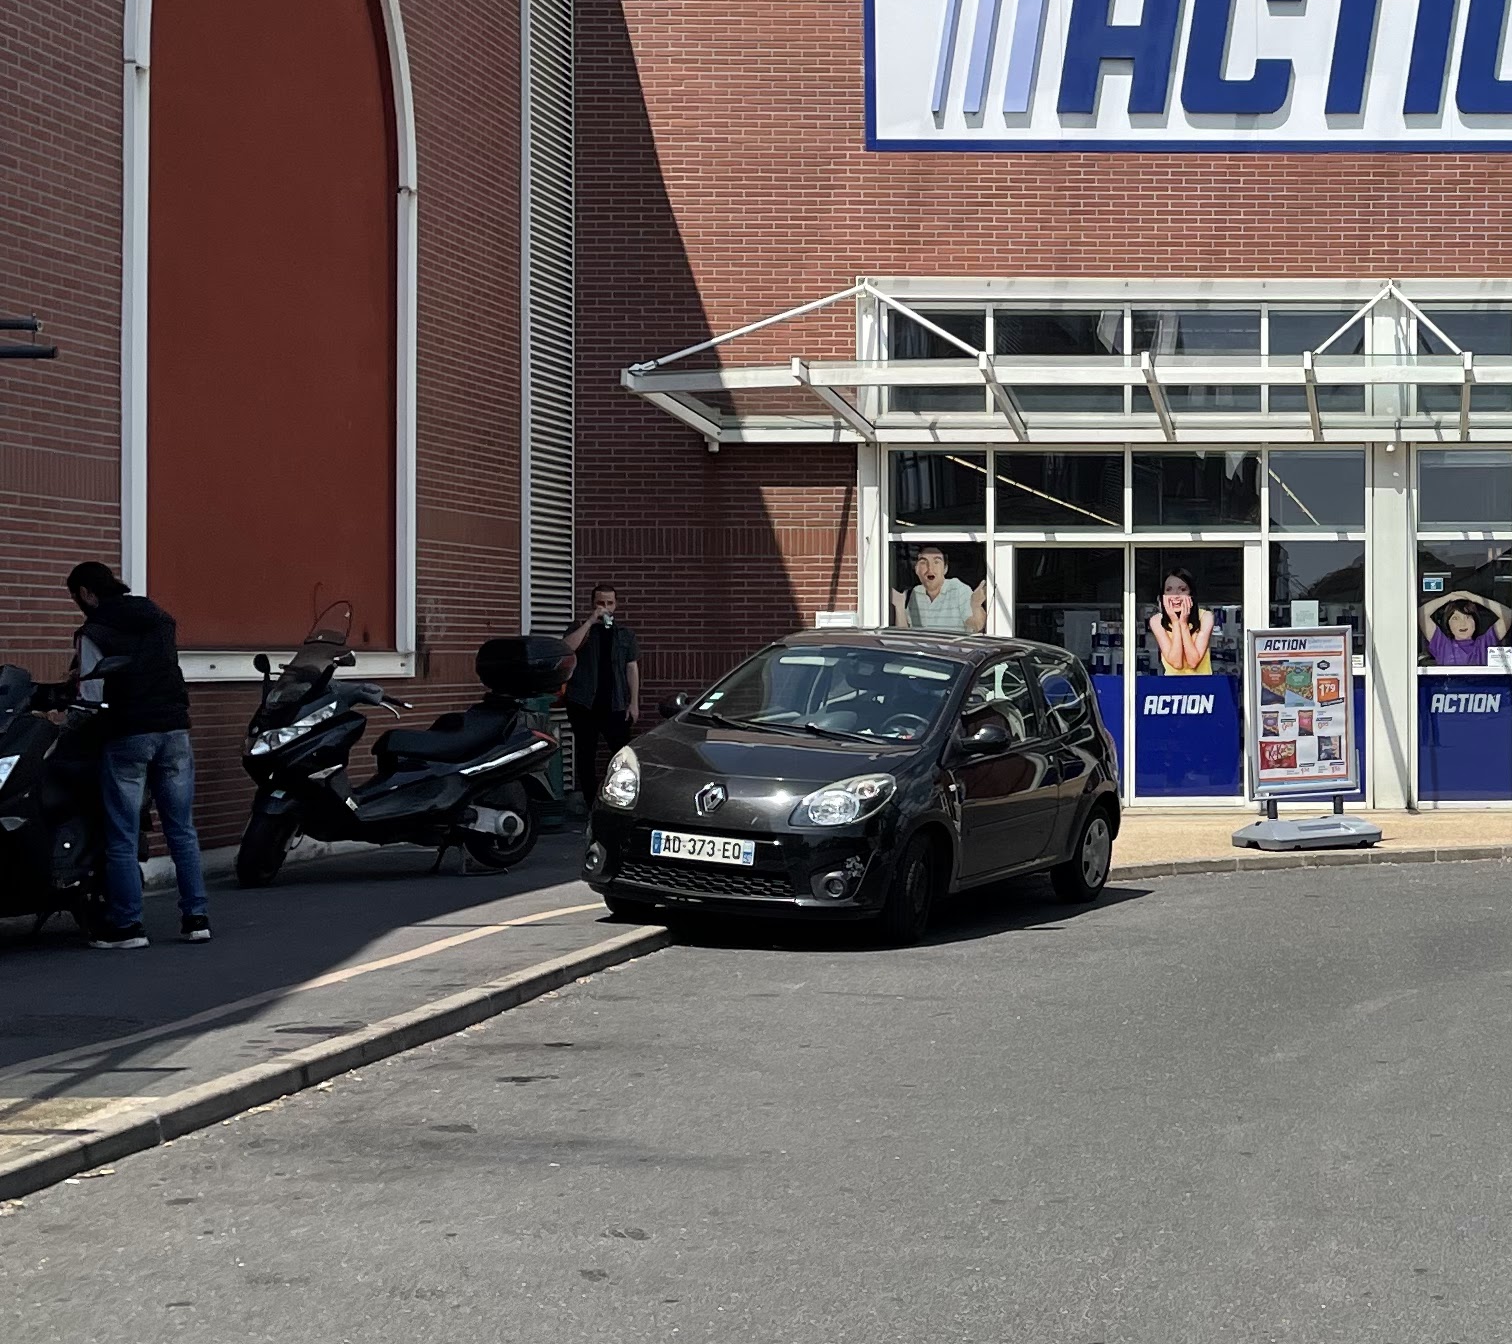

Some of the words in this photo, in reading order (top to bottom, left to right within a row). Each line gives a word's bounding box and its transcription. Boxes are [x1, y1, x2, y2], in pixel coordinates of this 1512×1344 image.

[1263, 639, 1308, 651] ACTION
[1143, 694, 1215, 715] ACTION
[1430, 693, 1502, 713] ACTION
